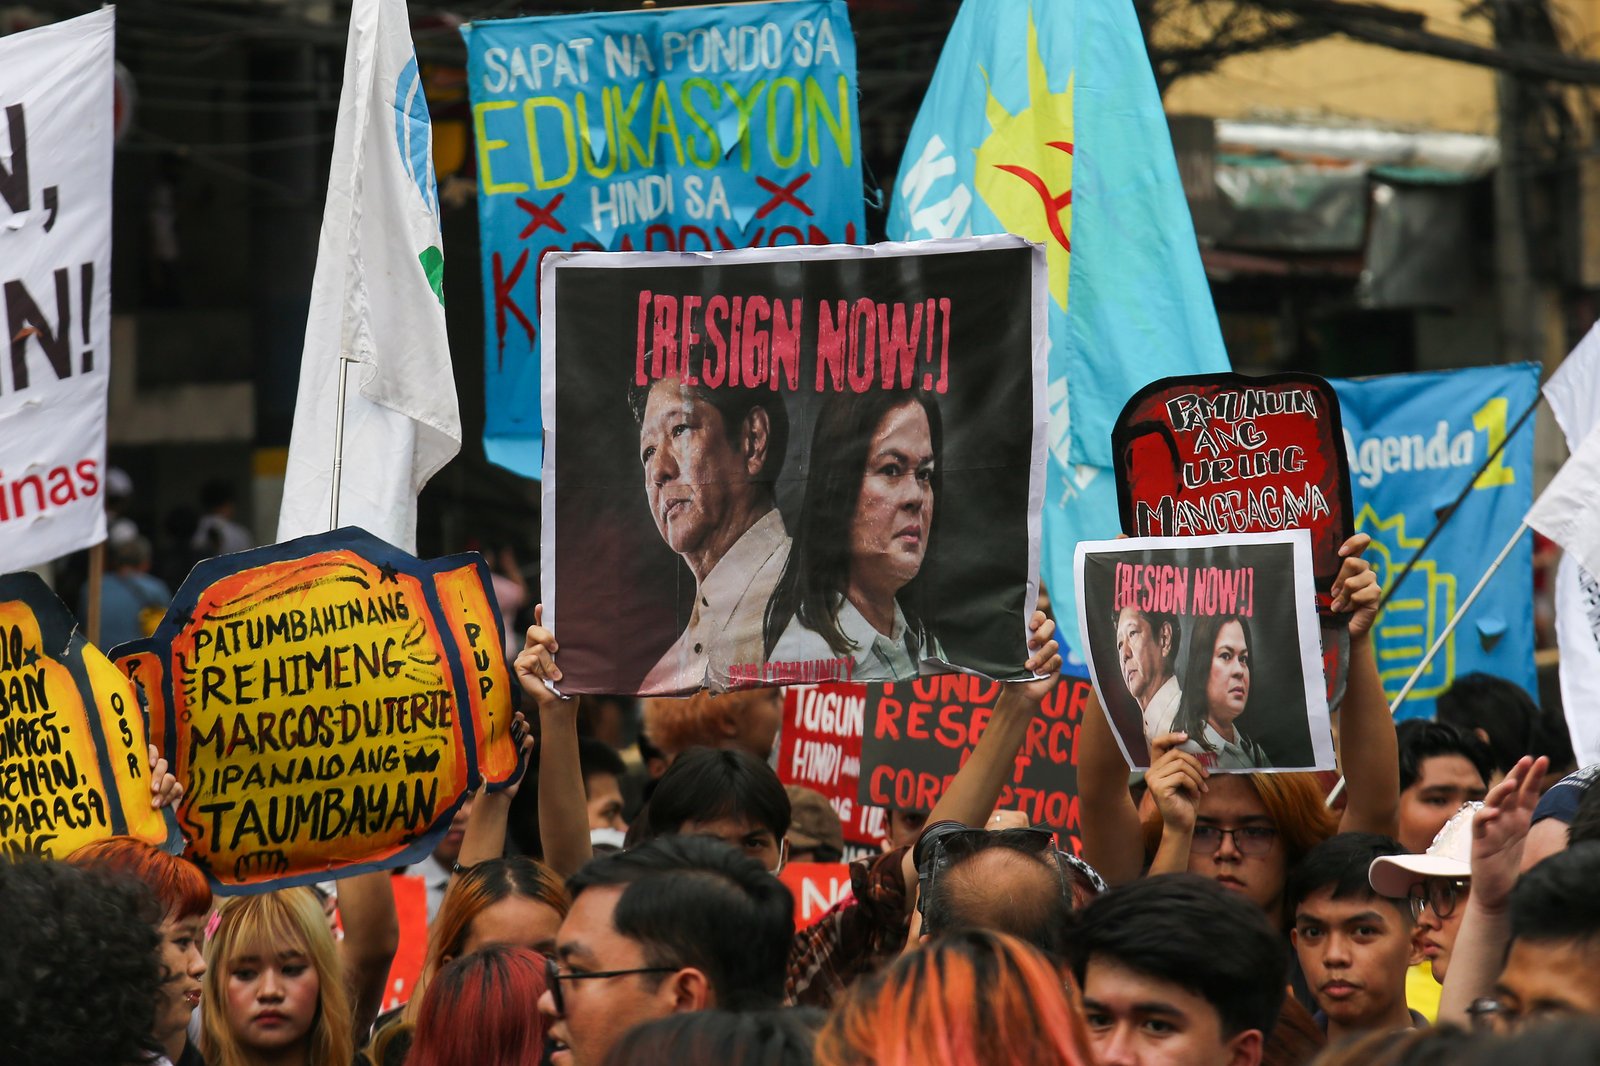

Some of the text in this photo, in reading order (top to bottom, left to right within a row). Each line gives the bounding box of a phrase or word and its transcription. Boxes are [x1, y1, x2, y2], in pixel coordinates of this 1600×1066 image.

[482, 17, 841, 93] SAPAT NA PONDO SA
[474, 74, 853, 195] EDUKASYON
[591, 174, 732, 231] HINDI SA
[0, 261, 94, 396] N!
[1183, 445, 1308, 489] URING
[1194, 421, 1267, 458] ANG
[1136, 481, 1330, 537] MANGGAGAWA
[201, 637, 406, 711] REHIMENG
[199, 777, 438, 853] TAUMBAYAN
